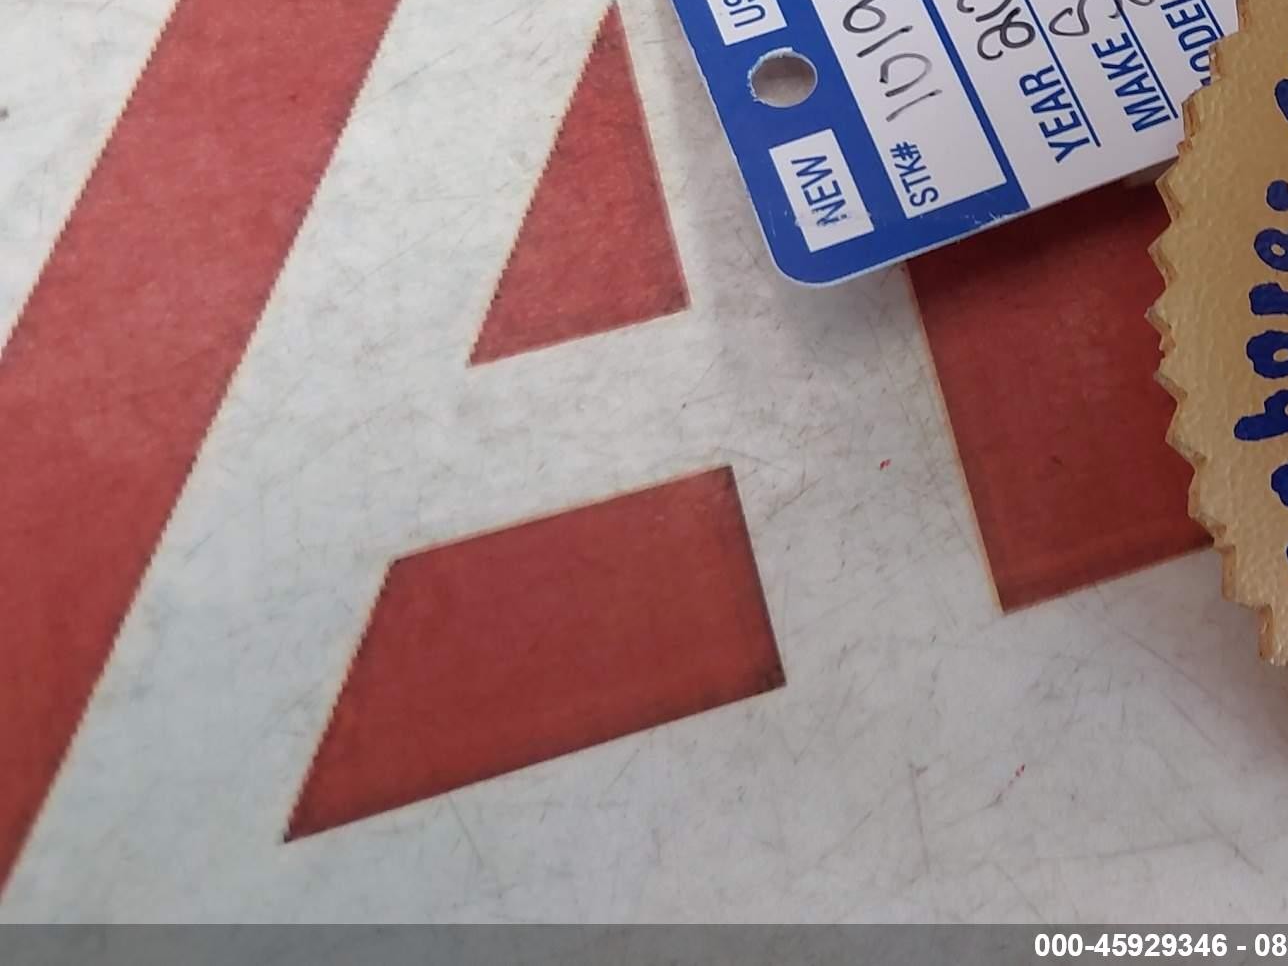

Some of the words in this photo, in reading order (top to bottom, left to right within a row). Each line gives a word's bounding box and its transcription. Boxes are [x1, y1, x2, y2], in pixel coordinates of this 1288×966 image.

[1018, 64, 1092, 165] YEAR
[1091, 31, 1172, 133] MAKE
[790, 154, 849, 228] NEW
[889, 141, 940, 208] STK#
